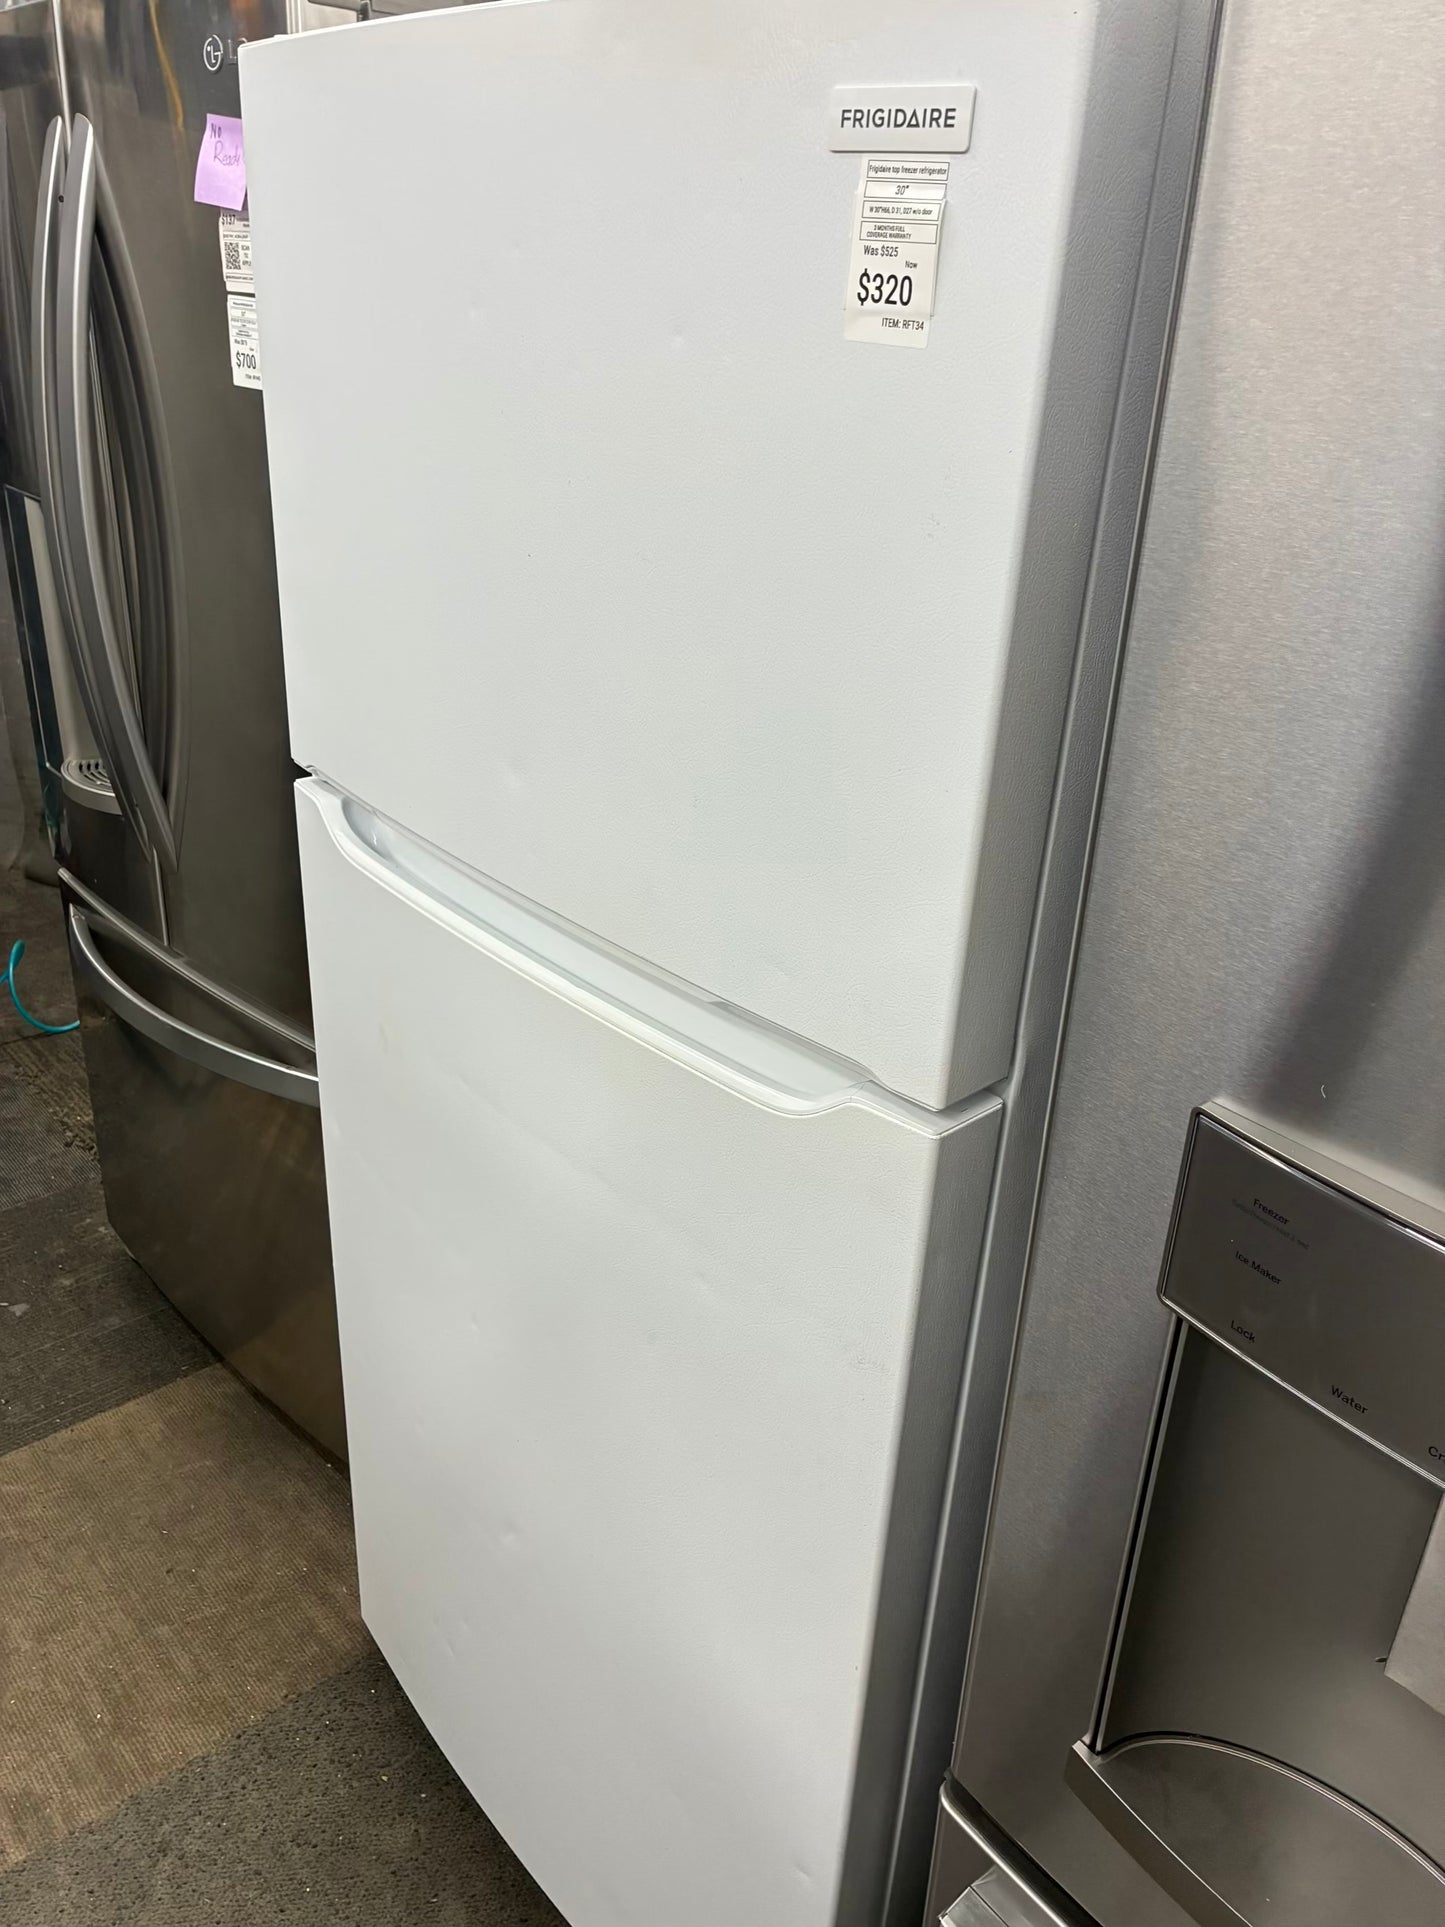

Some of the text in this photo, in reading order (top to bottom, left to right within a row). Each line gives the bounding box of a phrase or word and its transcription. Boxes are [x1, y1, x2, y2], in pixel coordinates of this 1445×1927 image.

[840, 107, 957, 129] FRIGIDAIRE
[869, 164, 947, 176] Frigidaire top freezer refrigerator
[866, 231, 912, 240] COVERAGE WARRANTY
[877, 224, 896, 232] MONTHS
[863, 244, 899, 258] Was $525
[905, 260, 918, 270] Now
[857, 268, 913, 307] $320
[881, 317, 924, 331] ITEM: RFT34
[236, 351, 257, 370] $700
[1252, 1197, 1290, 1226] Freezer
[1234, 1249, 1283, 1286] Ice Maker
[1229, 1319, 1256, 1344] Lock
[1330, 1384, 1369, 1415] Water
[1428, 1446, 1445, 1464] Cr
